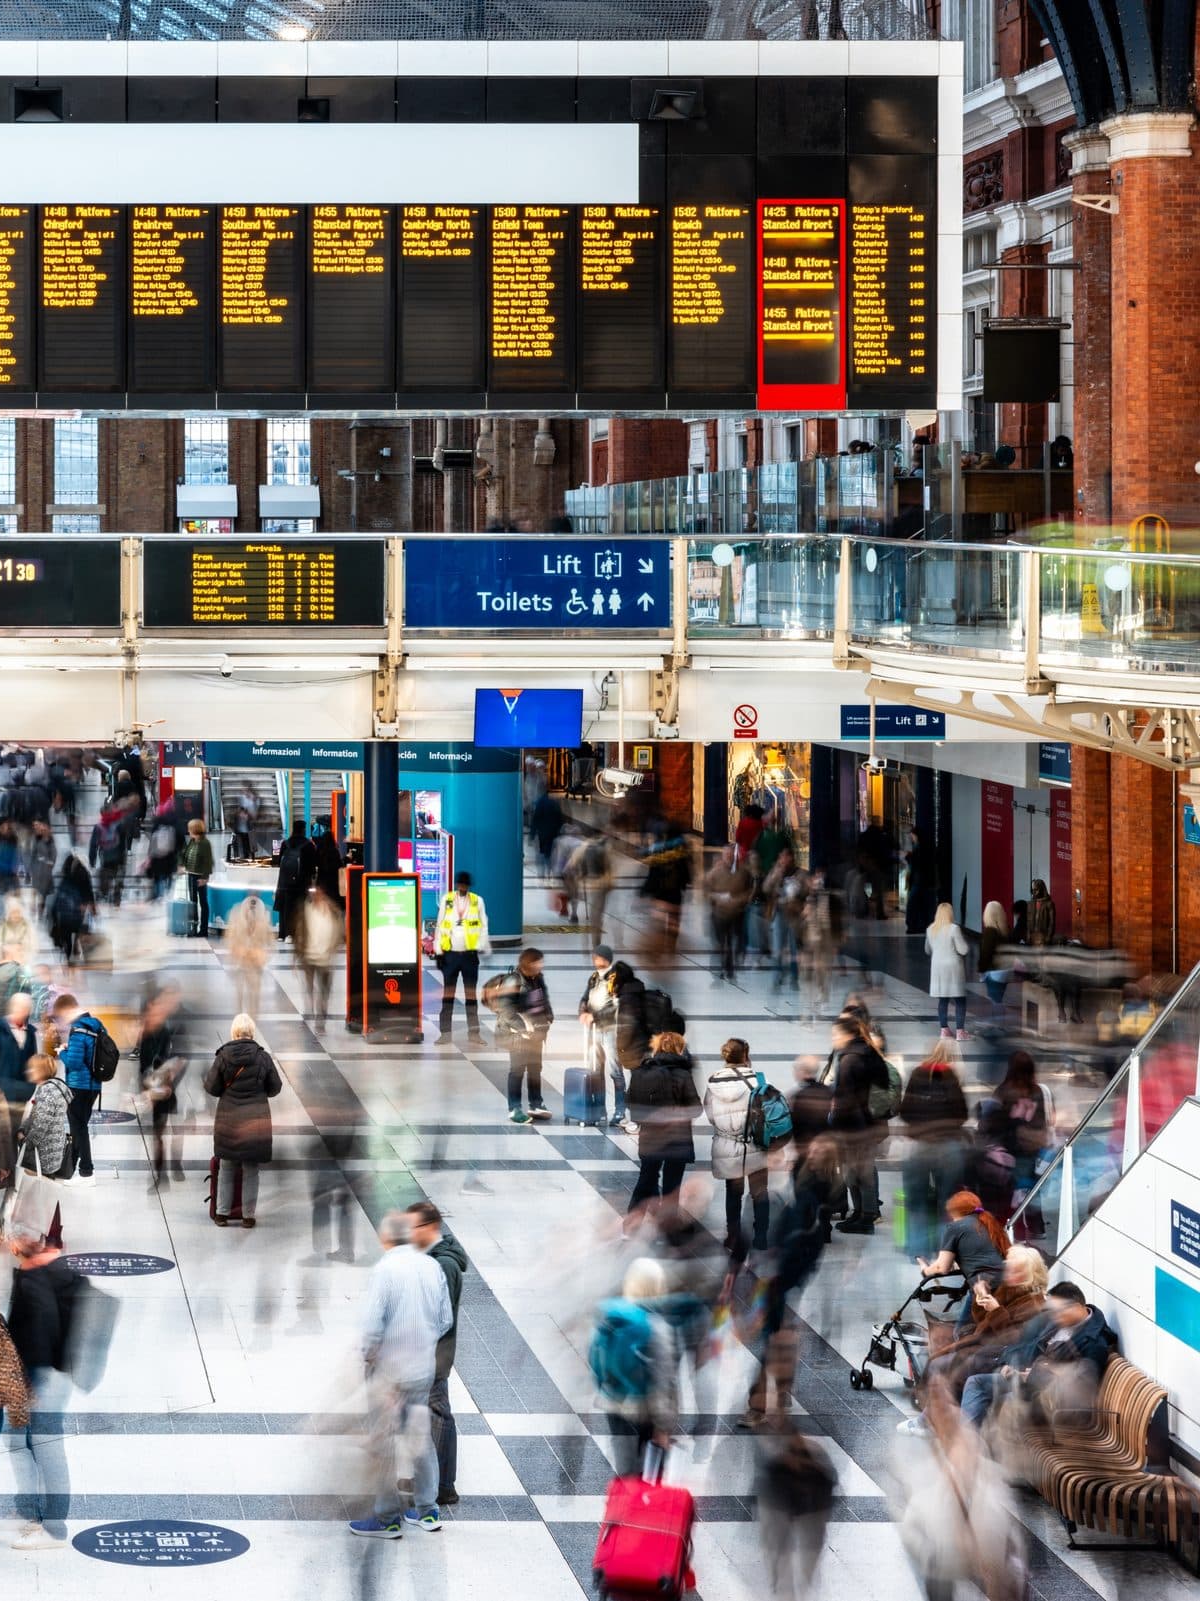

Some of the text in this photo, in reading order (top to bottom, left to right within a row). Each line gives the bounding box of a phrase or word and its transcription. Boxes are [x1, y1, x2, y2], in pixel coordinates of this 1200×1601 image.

[76, 207, 110, 216] Platform
[166, 207, 200, 216] Platform
[255, 207, 289, 217] Platform
[346, 207, 380, 217] Platform
[435, 207, 469, 216] Platform
[525, 207, 559, 217] Platform
[615, 207, 650, 217] Platform
[705, 207, 740, 217] Platform
[795, 207, 830, 216] Platform
[833, 207, 838, 216] 3
[44, 219, 83, 230] Chingford
[133, 220, 172, 229] Braintree
[223, 220, 275, 230] Southend Vic
[314, 220, 383, 230] Stansted Airport
[403, 220, 470, 231] Cambridge North
[493, 220, 543, 230] Enfield Town
[583, 220, 614, 229] Norwich
[673, 220, 702, 231] Ipswich
[763, 220, 832, 230] Stansted Airport
[795, 258, 830, 267] Platform
[763, 270, 833, 281] Stansted Airport
[795, 308, 830, 318] Platform
[763, 321, 834, 331] Stansted Airport
[544, 555, 582, 574] Lift
[16, 564, 36, 581] 30
[477, 592, 552, 611] Toilets
[896, 717, 911, 725] Lift
[252, 747, 300, 757] Informazioni
[313, 748, 358, 758] Information
[429, 751, 472, 762] Informacja
